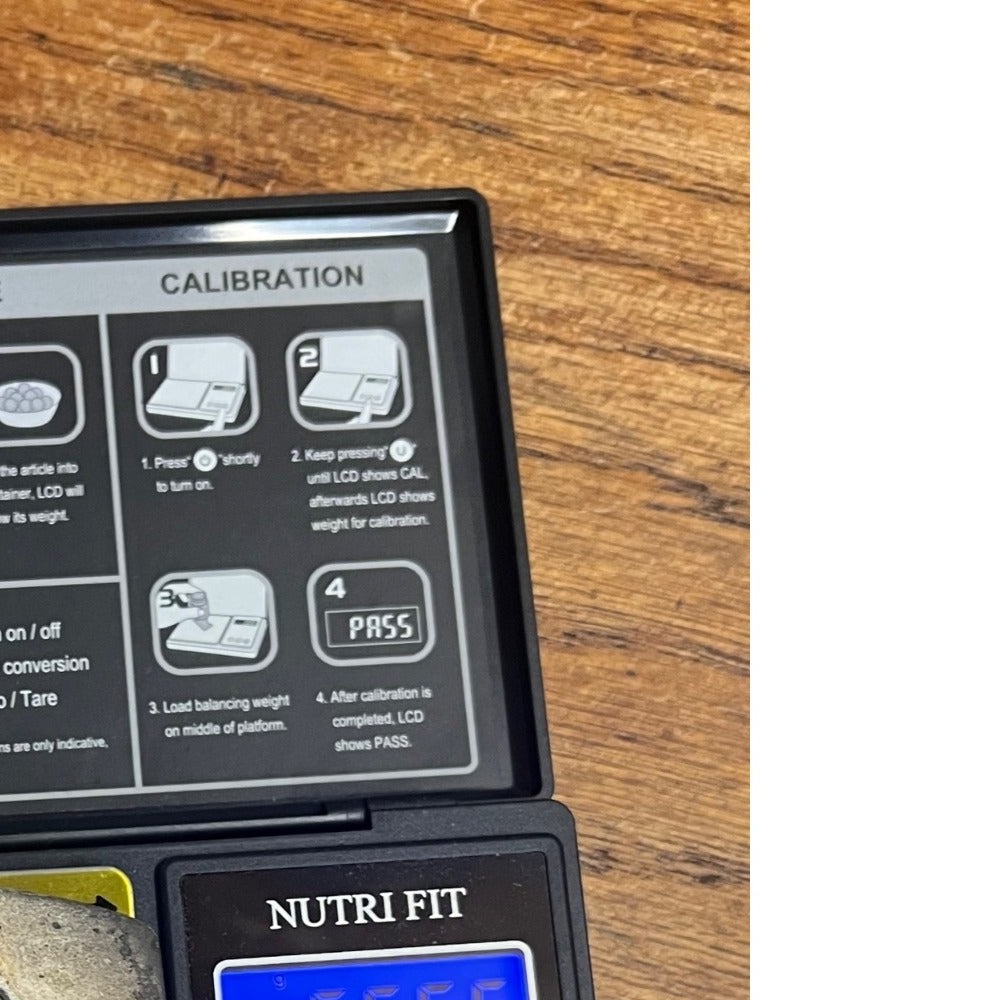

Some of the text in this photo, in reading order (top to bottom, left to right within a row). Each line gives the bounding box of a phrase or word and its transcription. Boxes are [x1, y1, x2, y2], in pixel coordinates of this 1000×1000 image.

[160, 265, 364, 295] CALIBRATION
[299, 348, 318, 368] 2
[290, 450, 303, 462] 2.
[305, 449, 335, 463] Keep
[0, 465, 18, 477] the
[20, 463, 55, 476] article
[56, 462, 79, 474] into
[307, 469, 398, 484] until LCD shows
[36, 485, 63, 499] LCD
[65, 484, 84, 497] will
[156, 481, 168, 492] to
[195, 480, 214, 491] on.
[309, 491, 436, 508] afterwards LCD shows
[12, 511, 27, 523] its
[311, 515, 430, 533] weight for calibration.
[325, 577, 346, 598] 4
[5, 625, 26, 641] on
[40, 622, 61, 639] off
[349, 613, 413, 640] PASS
[3, 655, 90, 675] conversion
[20, 690, 58, 707] Tare
[316, 686, 431, 703] 4. After calibration is
[148, 694, 290, 714] 3. Load balancing weight
[398, 710, 424, 723] LCD
[164, 720, 288, 737] on middle of platform.
[13, 742, 30, 752] are
[32, 739, 54, 753] only
[335, 735, 412, 752] shows PASS.
[266, 887, 467, 930] NUTRI FIT
